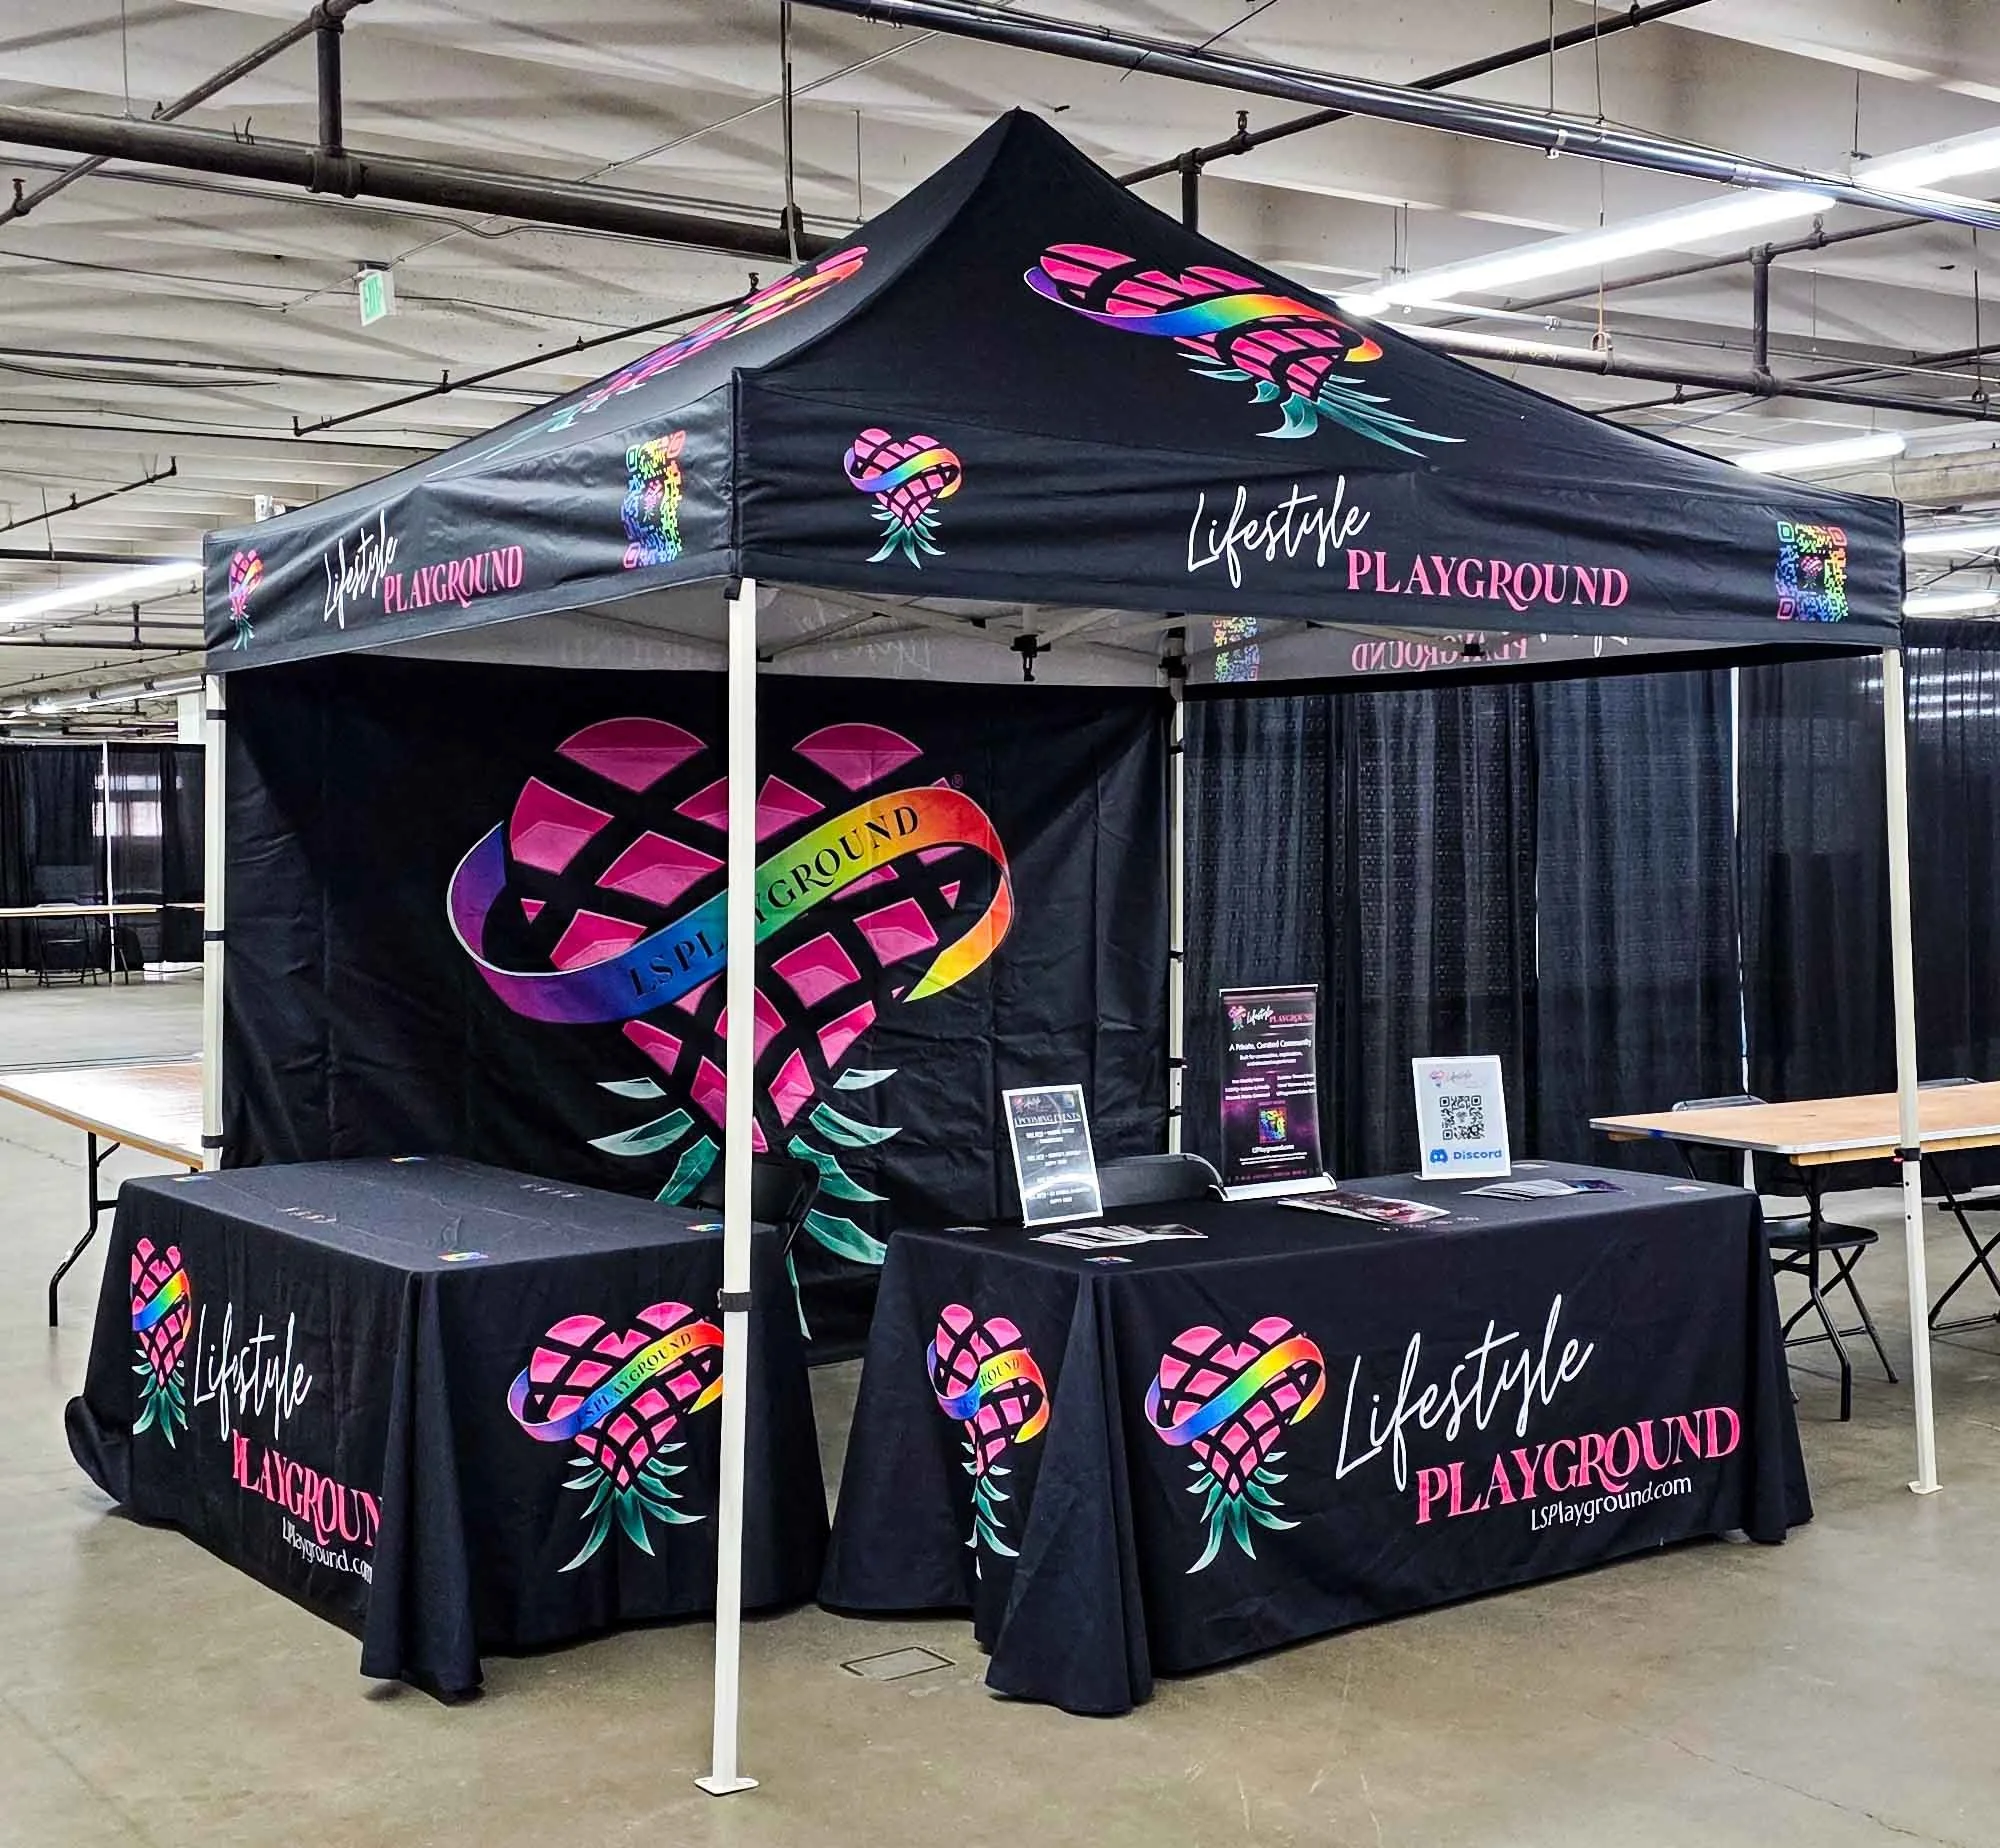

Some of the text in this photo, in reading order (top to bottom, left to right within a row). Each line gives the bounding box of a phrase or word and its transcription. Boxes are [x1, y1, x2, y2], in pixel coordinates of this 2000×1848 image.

[323, 508, 399, 630] Lifestyle
[383, 545, 525, 614] PLAYGROUND
[1187, 474, 1371, 590] Lifestyle
[1345, 548, 1629, 612] PLAYGROUND
[628, 804, 920, 998] LSPLYGROUND
[1453, 1149, 1502, 1161] Discord
[193, 1301, 313, 1442] Lifestyle
[1335, 1293, 1595, 1492] Lifestyle
[231, 1427, 383, 1548] PLAYGROUN
[1415, 1405, 1742, 1526] PLAYGROUND
[1530, 1474, 1693, 1532] LSPlayground.com
